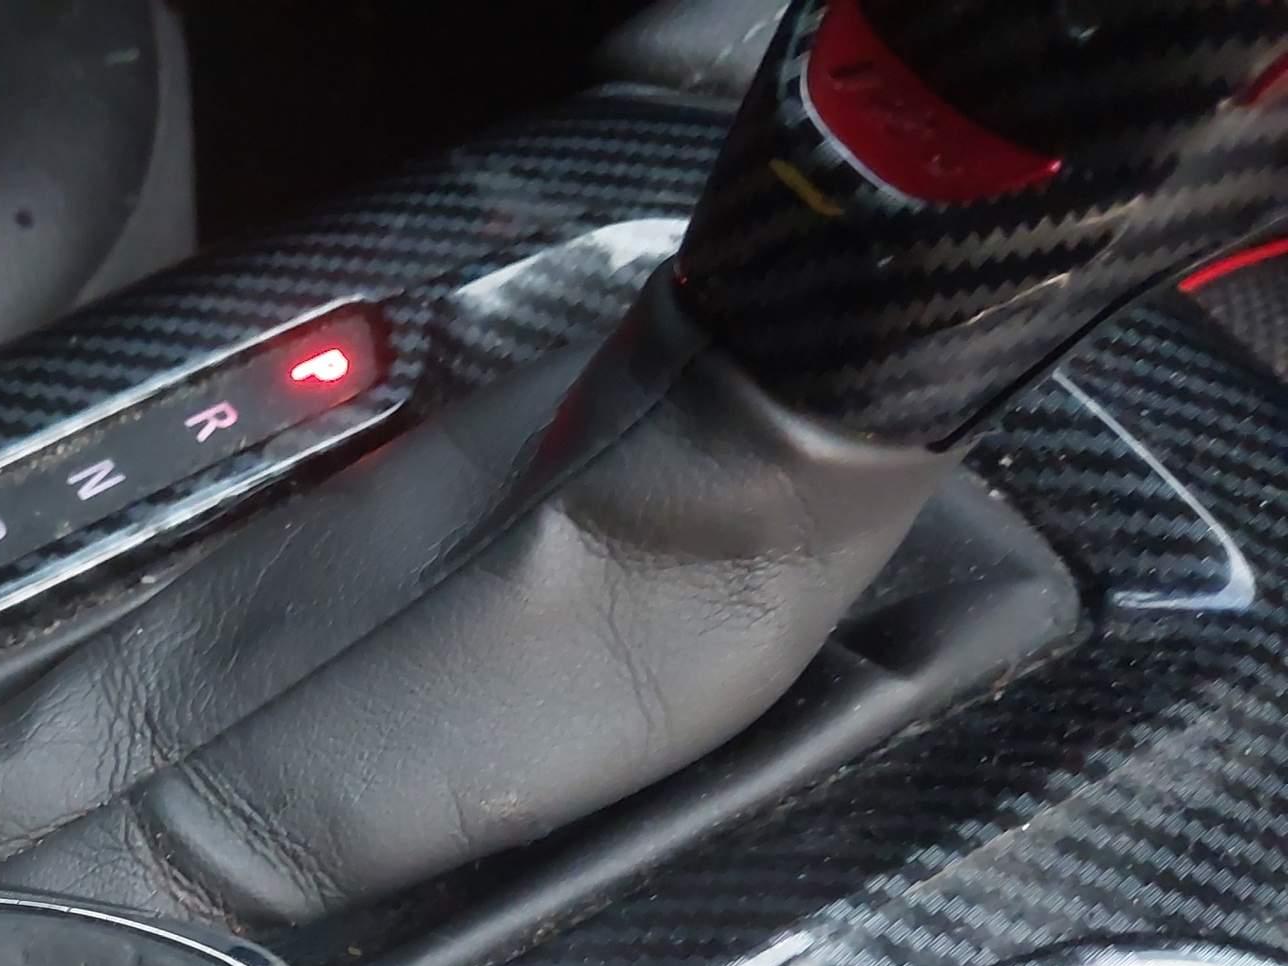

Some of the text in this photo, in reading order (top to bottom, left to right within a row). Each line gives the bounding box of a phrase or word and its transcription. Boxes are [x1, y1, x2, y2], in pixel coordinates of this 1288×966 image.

[291, 347, 348, 382] P
[184, 401, 238, 443] R
[67, 459, 126, 501] N
